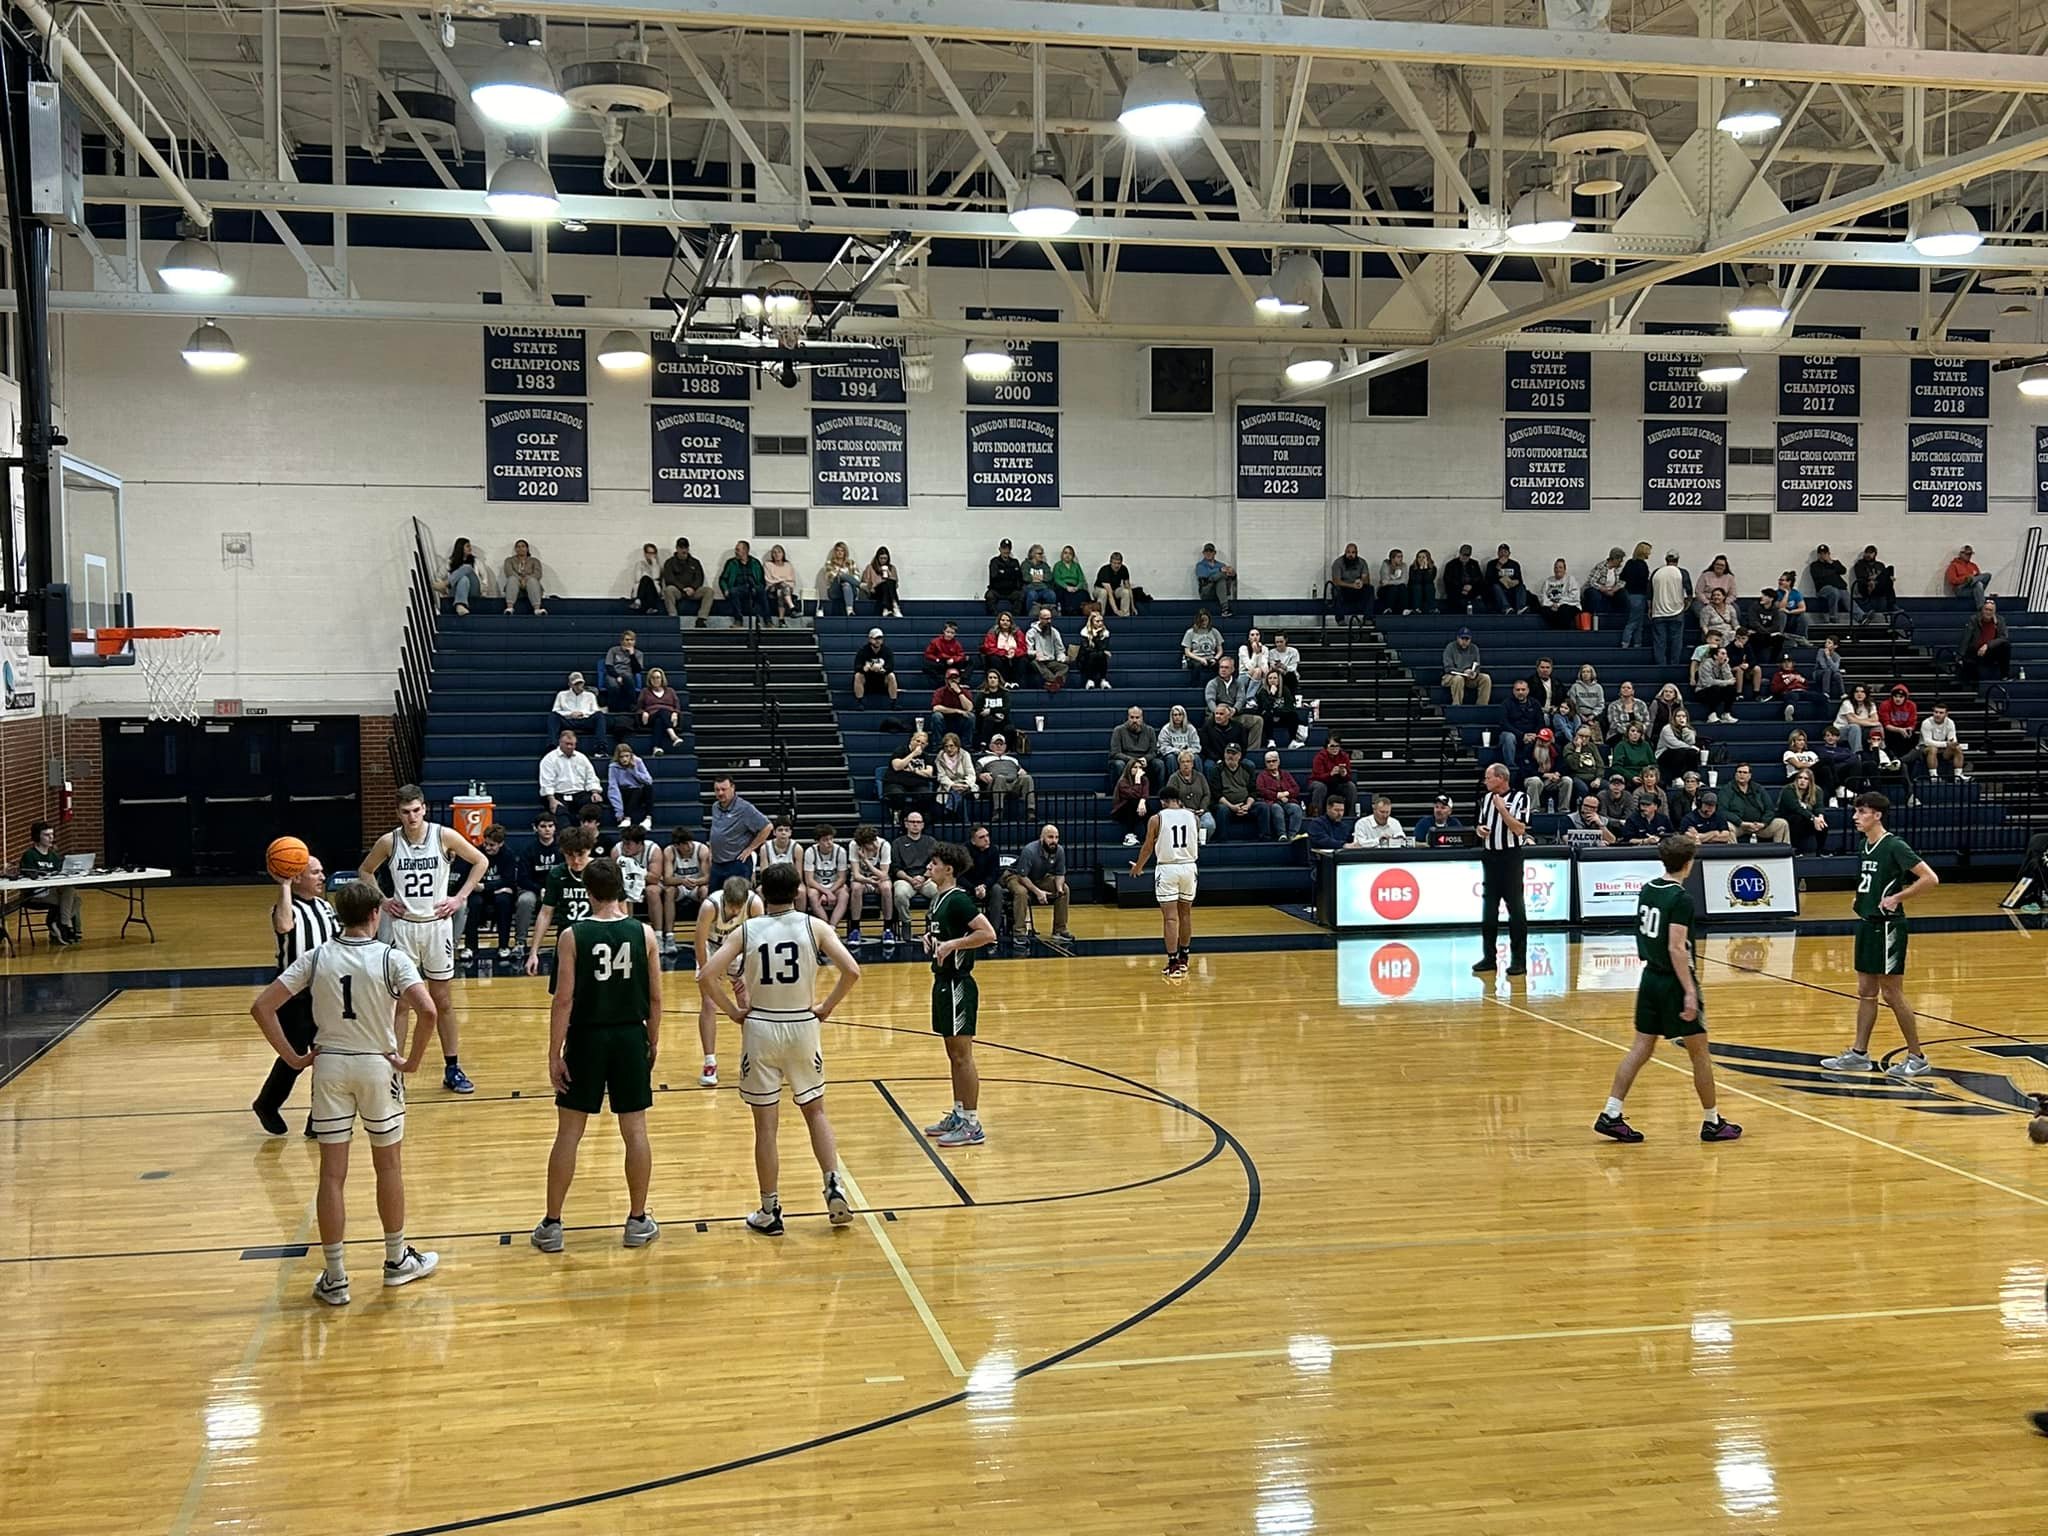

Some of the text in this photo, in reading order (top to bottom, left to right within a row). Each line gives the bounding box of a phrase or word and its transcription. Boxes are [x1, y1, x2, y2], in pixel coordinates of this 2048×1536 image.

[489, 326, 582, 339] VOLLEYBALL
[513, 342, 557, 354] STATE
[1005, 340, 1032, 351] OLF
[1531, 350, 1566, 360] GOLF
[1647, 352, 1681, 362] GIRLS
[1803, 355, 1836, 365] GOLF
[491, 358, 580, 371] CHAMPIONS
[656, 362, 744, 376] CHAMPIONS
[1934, 358, 1966, 368] GOLF
[817, 367, 900, 379] CHAMPIONS
[1530, 364, 1567, 375] STATE
[1802, 369, 1838, 380] STATE
[516, 374, 556, 389] 1983
[1933, 372, 1967, 382] STATE
[681, 378, 720, 393] 1988
[840, 382, 877, 397] 1994
[1510, 378, 1586, 390] CHAMPIONS
[1649, 381, 1723, 392] CHAMPIONS
[1784, 383, 1856, 394] CHAMPIONS
[995, 385, 1031, 400] 2000
[1915, 386, 1985, 397] CHAMPIONS
[1531, 393, 1565, 407] 2015
[1669, 395, 1703, 409] 2017
[1802, 398, 1835, 411] 2017
[1933, 400, 1965, 413] 2018
[490, 409, 583, 429] ABINGDON HIGH SCHOOL
[656, 412, 745, 433] ABINGDON HIGH SCHOOL
[1241, 411, 1322, 431] ABINGDON HIGH SCHOOL
[816, 416, 902, 436] ABINGDON HIGH SCHOOL
[971, 418, 1054, 438] ABINGDON HIGH SCHOOL
[517, 433, 558, 445] GOLF
[1242, 434, 1320, 446] NATIONAL GUARD CUP
[1508, 425, 1586, 444] ABINGDON HIGH SCHOOL
[1647, 427, 1723, 445] ABINGDON HIGH SCHOOL
[1780, 428, 1854, 447] ABINGDON HIGH SCHOOL
[1912, 430, 1983, 449] ABINGDON HIGH SCHOOL
[681, 436, 721, 448] GOLF
[816, 440, 903, 452] BOYS CROSS COUNTRY
[973, 442, 1054, 454] BOYS INDOOR TRACK
[515, 450, 560, 462] STATE
[680, 453, 723, 464] STATE
[1273, 450, 1289, 461] FOR
[1507, 447, 1588, 459] BOYS OUTDOOR TRACK
[1668, 449, 1703, 460] GOLF
[1778, 451, 1857, 462] GIRLS CROSS COUNTRY
[1911, 452, 1983, 463] BOYS CROSS COUNTRY
[839, 456, 880, 467] STATE
[993, 458, 1033, 469] STATE
[1529, 462, 1566, 473] STATE
[493, 465, 583, 478] CHAMPIONS
[658, 469, 745, 481] CHAMPIONS
[1240, 465, 1323, 477] ATHLETIC EXCELLENCE
[1666, 464, 1704, 474] STATE
[1799, 465, 1835, 476] STATE
[1930, 467, 1964, 477] STATE
[818, 471, 902, 483] CHAMPIONS
[973, 472, 1054, 485] CHAMPIONS
[1510, 477, 1585, 488] CHAMPIONS
[518, 482, 558, 496] 2020
[1264, 480, 1299, 494] 2023
[1648, 478, 1722, 489] CHAMPIONS
[1781, 479, 1853, 490] CHAMPIONS
[1912, 481, 1983, 492] CHAMPIONS
[683, 484, 721, 498] 2021
[842, 487, 879, 500] 2021
[996, 488, 1032, 501] 2022
[1530, 491, 1565, 505] 2022
[1668, 492, 1702, 506] 2022
[1801, 493, 1834, 507] 2022
[1931, 494, 1963, 508] 2022
[217, 702, 240, 714] EXIT
[468, 811, 480, 823] G
[1171, 825, 1187, 848] 11
[404, 873, 433, 897] 22
[1595, 882, 1621, 890] Blue
[1734, 878, 1765, 893] PVB
[1377, 886, 1412, 902] HBS
[567, 901, 591, 920] 32
[1638, 904, 1661, 938] 30
[591, 941, 633, 981] 34
[758, 941, 800, 985] 13
[340, 974, 357, 1020] 1
